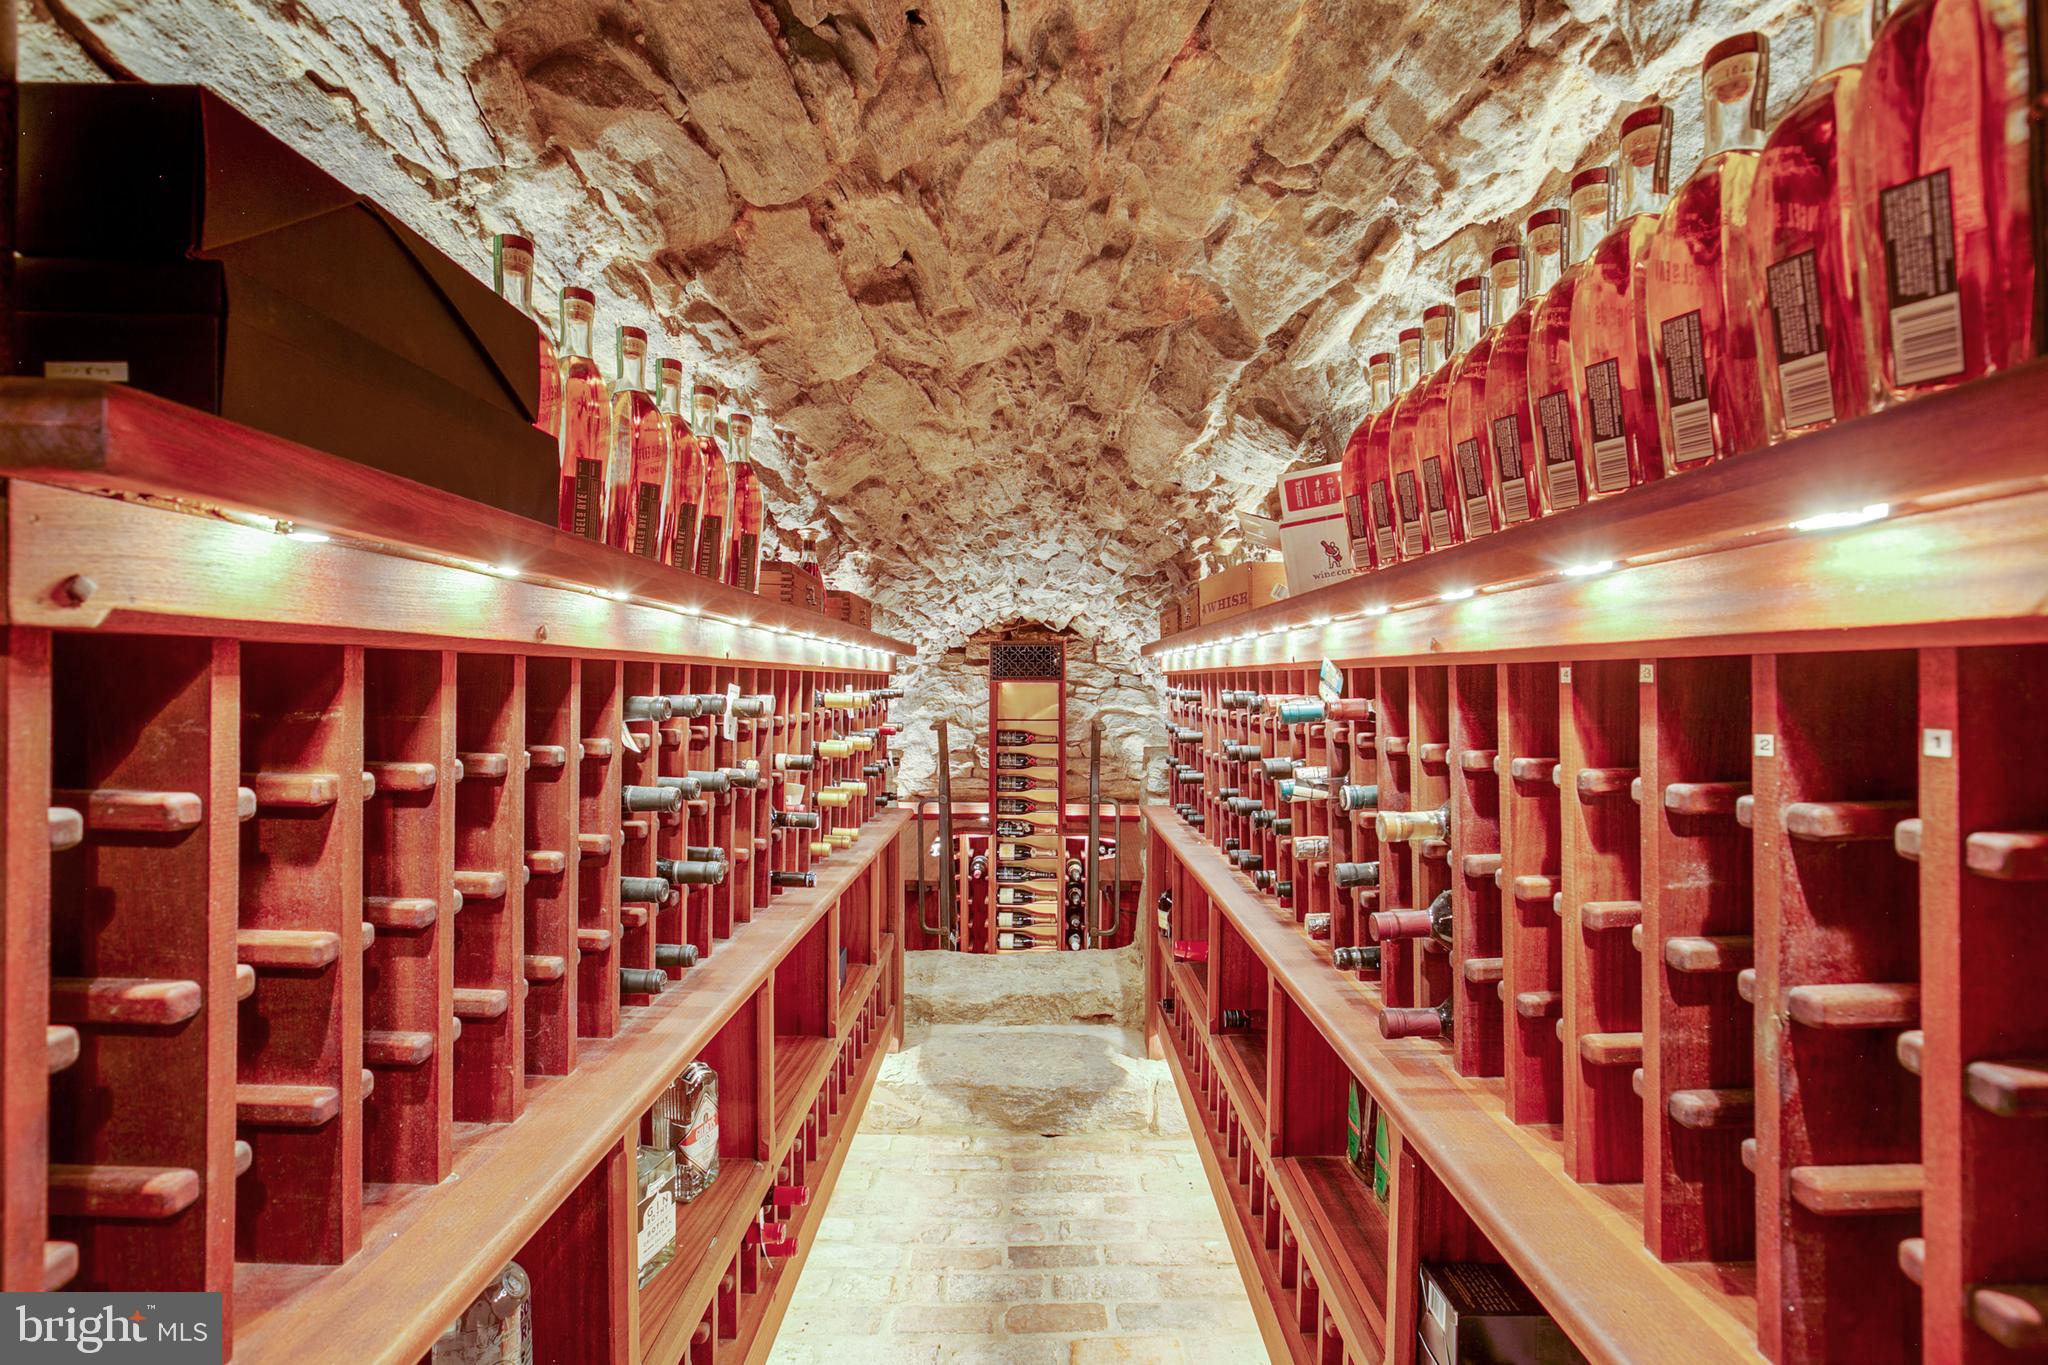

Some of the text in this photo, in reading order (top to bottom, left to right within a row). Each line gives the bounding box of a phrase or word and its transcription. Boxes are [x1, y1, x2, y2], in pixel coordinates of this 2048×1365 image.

[1643, 667, 1651, 679] 3
[1760, 739, 1770, 751] 2
[1933, 736, 1941, 749] 1
[647, 1193, 669, 1217] GIN
